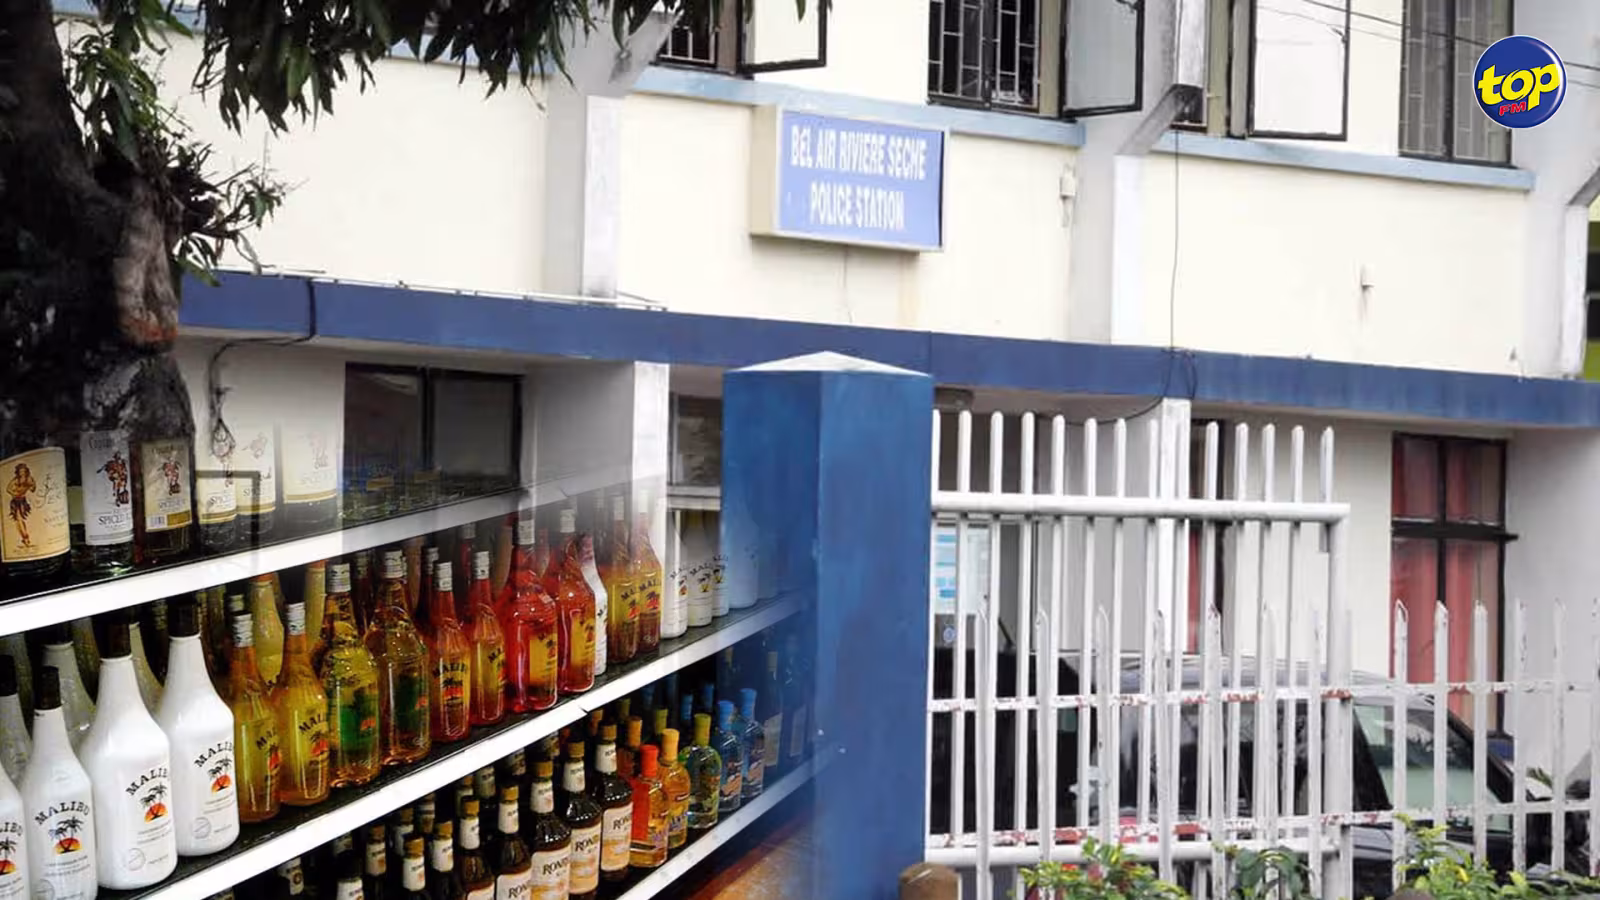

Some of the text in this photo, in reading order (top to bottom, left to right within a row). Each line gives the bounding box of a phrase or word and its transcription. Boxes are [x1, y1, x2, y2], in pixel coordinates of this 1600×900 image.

[790, 125, 927, 180] BEL AIR RIVIERE SECHE
[810, 181, 905, 230] POLICE STATION
[34, 801, 90, 826] MALIBU
